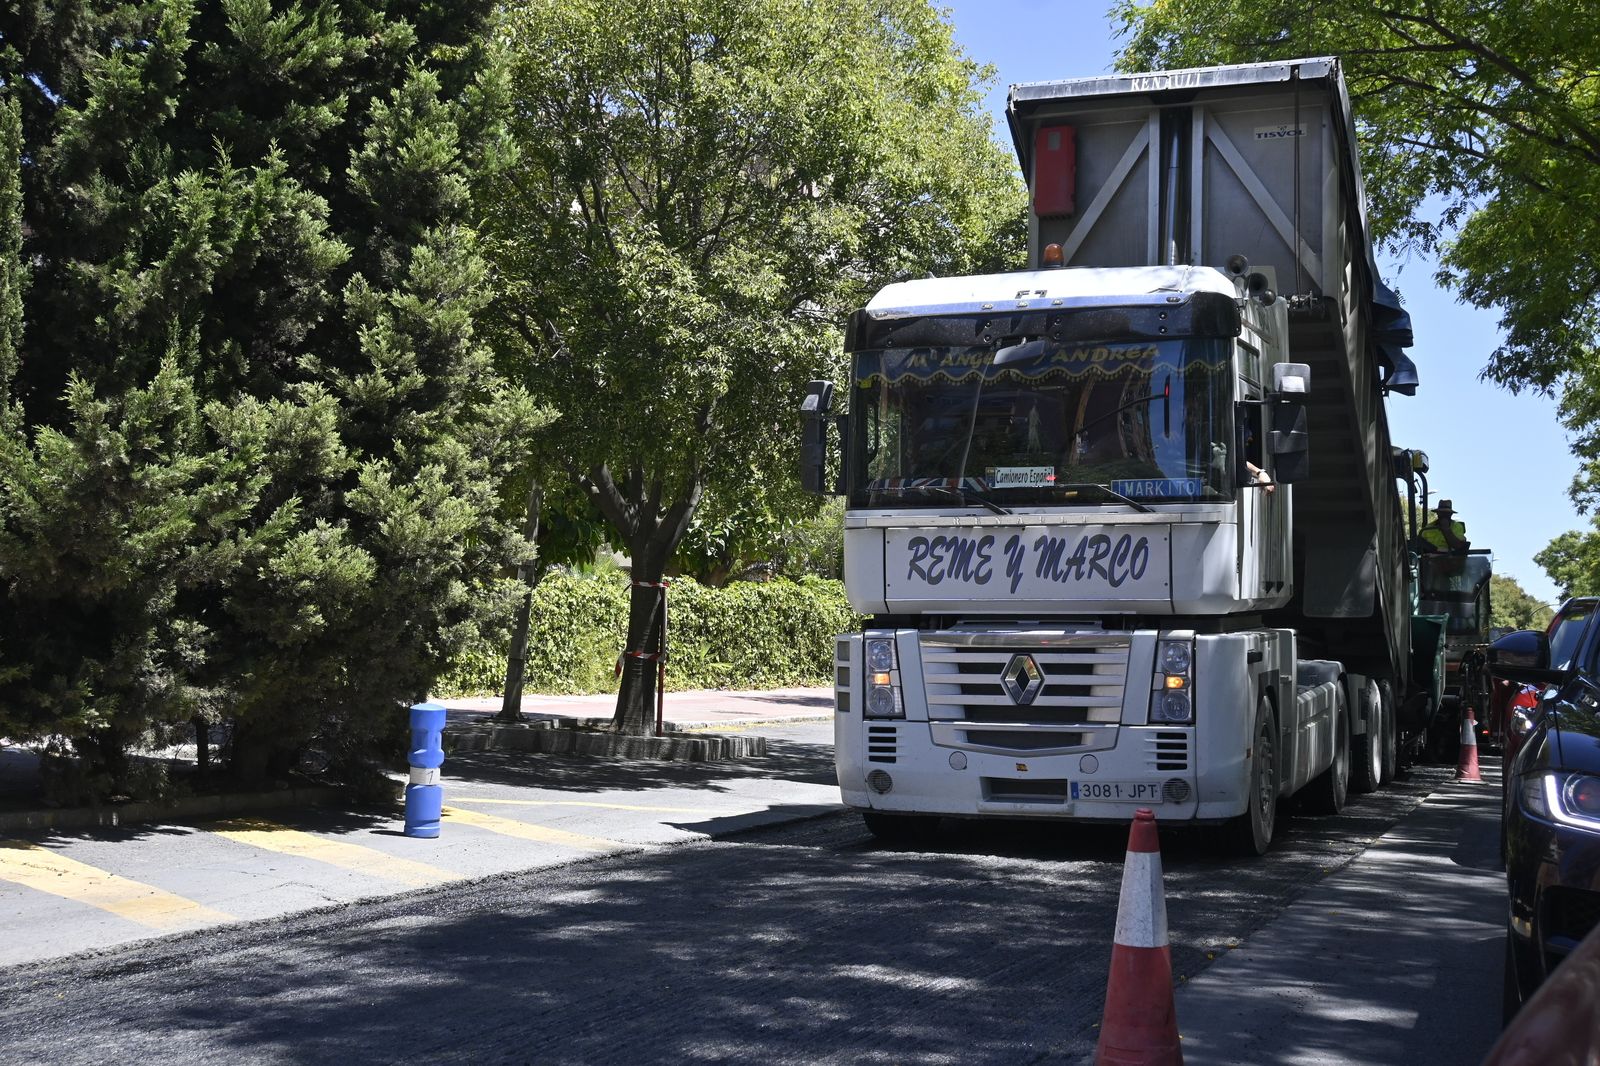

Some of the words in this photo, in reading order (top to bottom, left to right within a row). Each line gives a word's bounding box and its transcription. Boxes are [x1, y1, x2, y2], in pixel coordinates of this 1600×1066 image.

[1256, 129, 1304, 139] TISVOL
[996, 469, 1028, 484] Camionero
[907, 535, 995, 585] REME
[1034, 533, 1149, 588] MARCO
[1082, 784, 1120, 798] 3081
[1128, 784, 1157, 798] JPT
